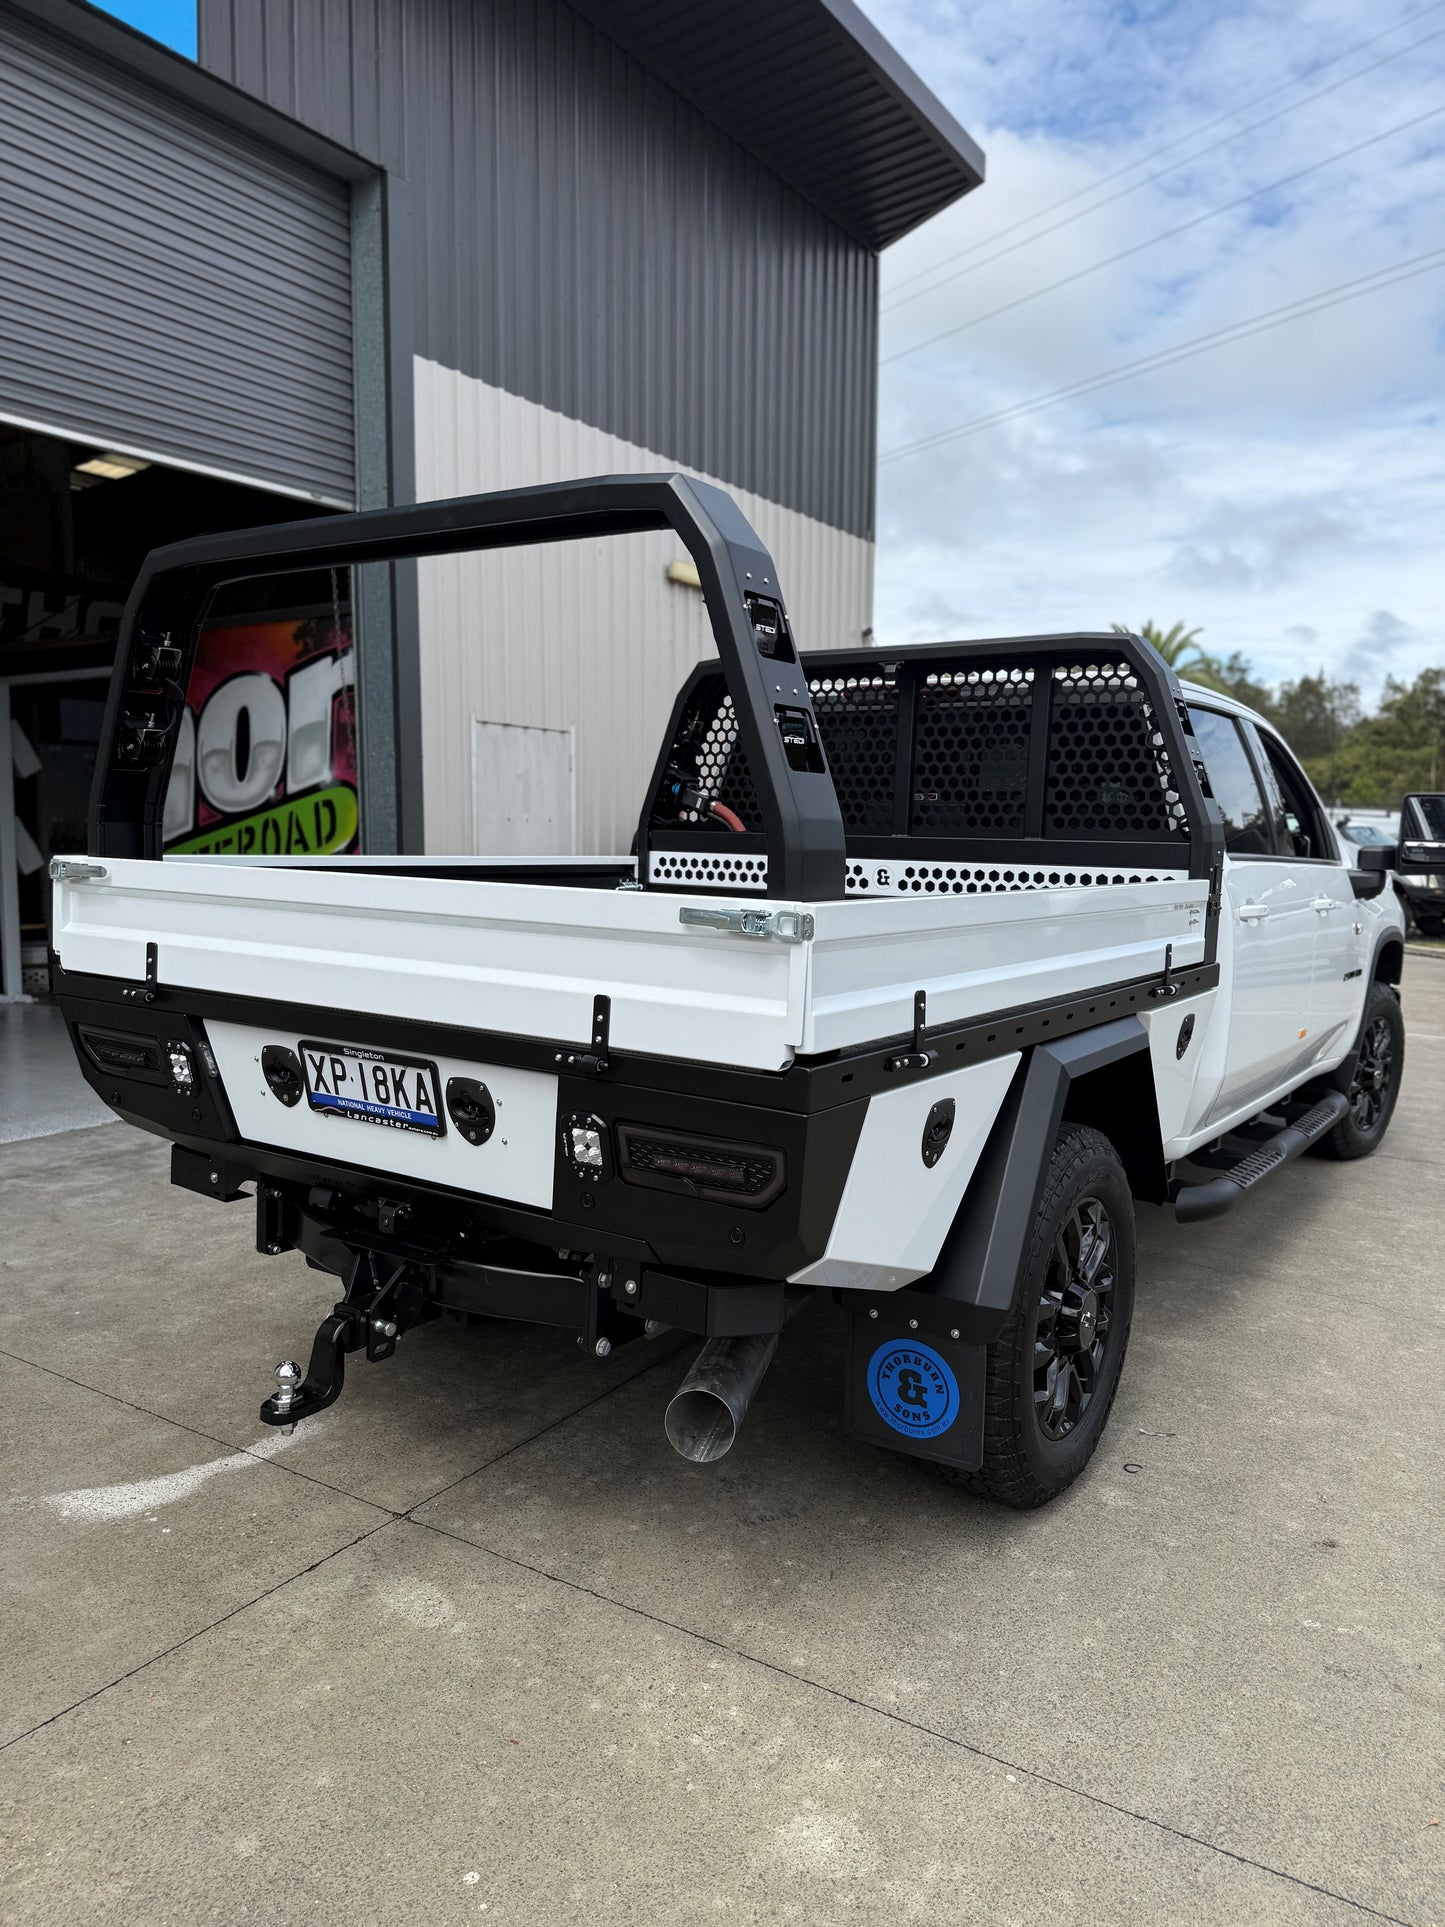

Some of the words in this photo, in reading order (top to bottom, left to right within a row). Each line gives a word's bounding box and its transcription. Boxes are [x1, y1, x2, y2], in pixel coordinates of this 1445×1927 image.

[343, 1047, 385, 1061] Singleton
[337, 1098, 365, 1110] NATIONAL
[366, 1104, 385, 1115] HEAVY
[386, 1108, 412, 1120] VEHICLE
[346, 1110, 409, 1129] Lancaster
[882, 1354, 945, 1395] THORBURN
[897, 1368, 928, 1409] &
[894, 1403, 931, 1422] SONS
